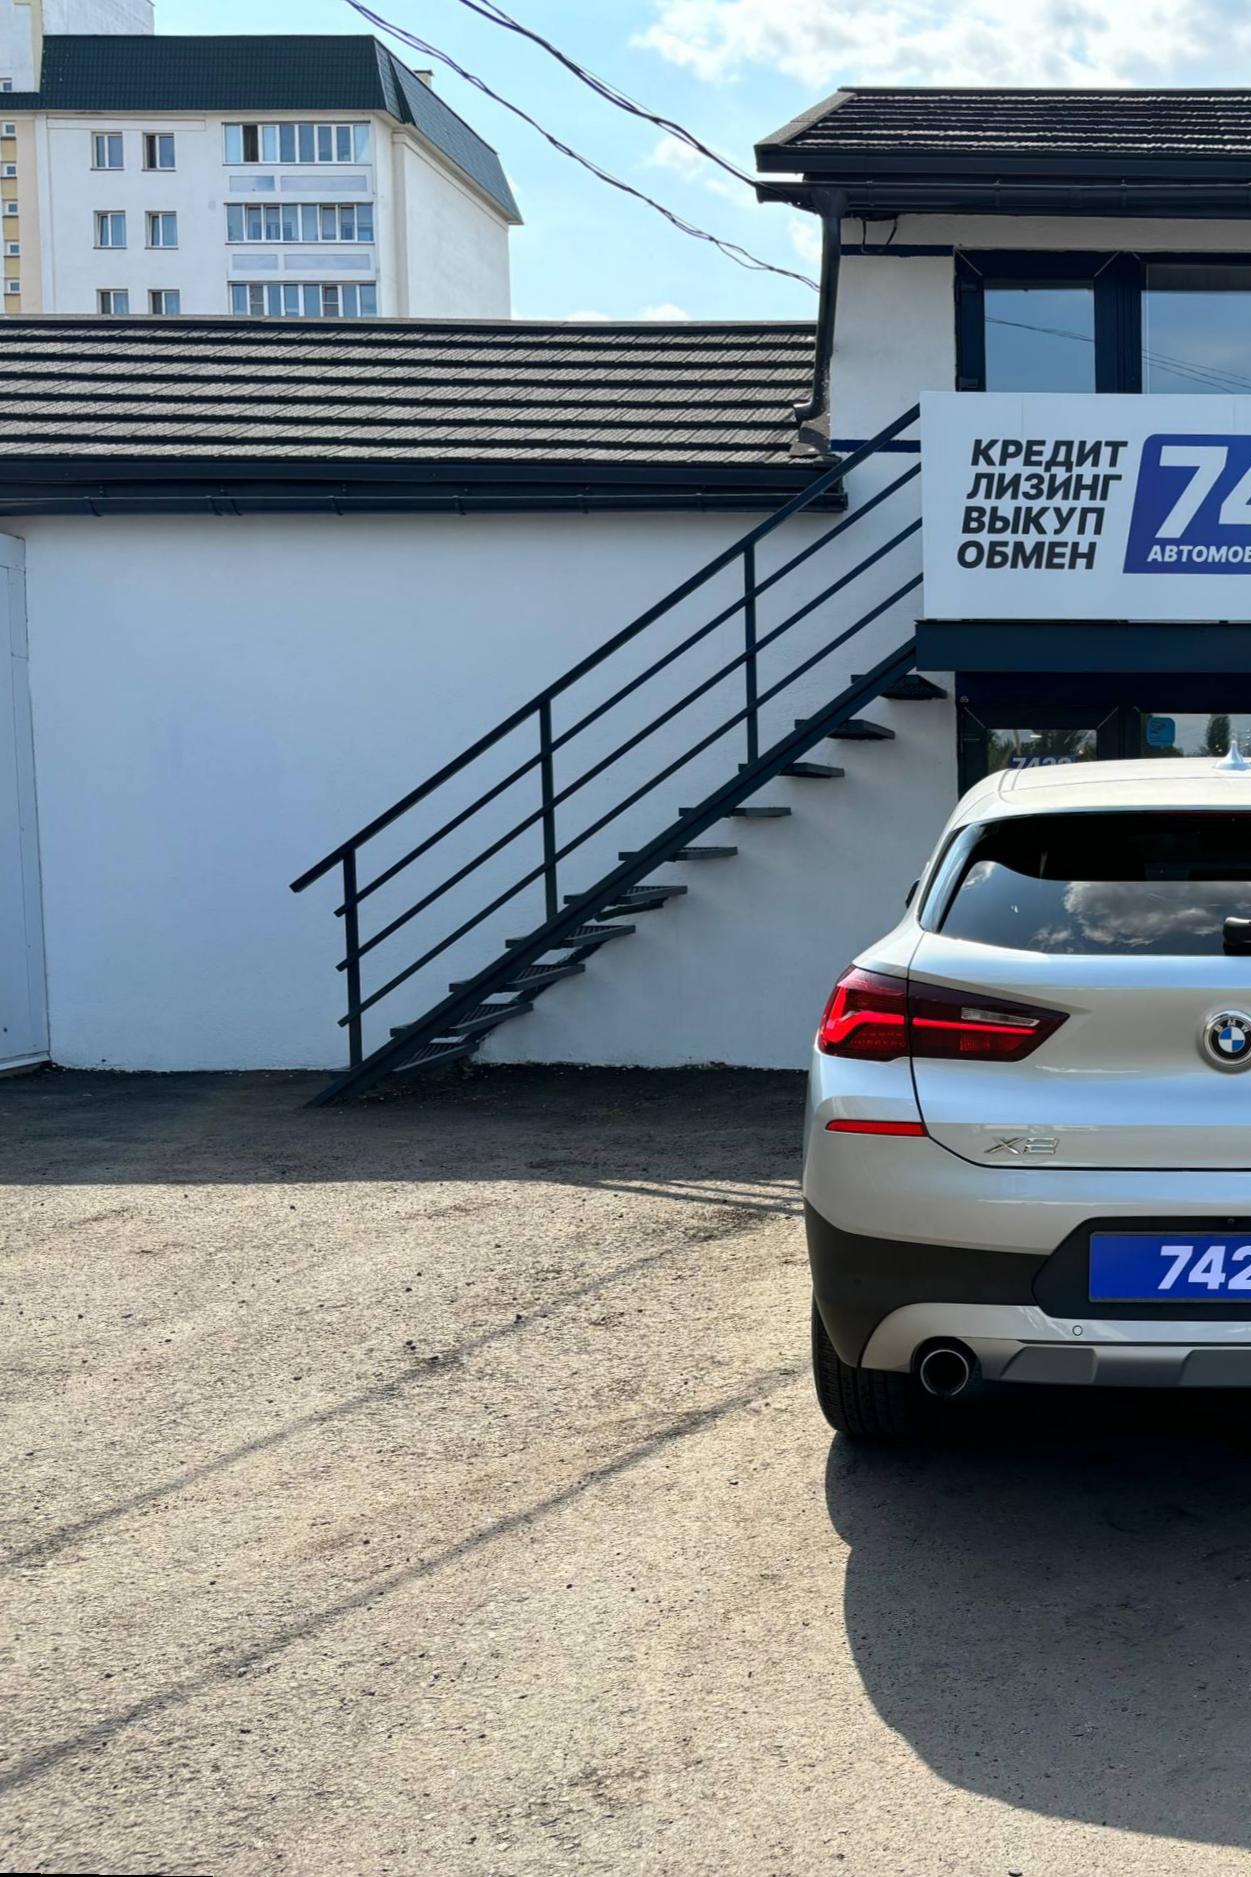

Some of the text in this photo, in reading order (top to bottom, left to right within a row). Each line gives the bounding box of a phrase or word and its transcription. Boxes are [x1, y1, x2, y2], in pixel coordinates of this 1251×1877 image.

[970, 438, 1129, 473] КРЕДИТ
[966, 472, 1123, 501] ЛИЗИНГ
[961, 505, 1106, 536] ВЫКУП
[957, 540, 1097, 570] ОБМЕН
[1213, 1018, 1251, 1033] BMW
[983, 1136, 1060, 1156] X2
